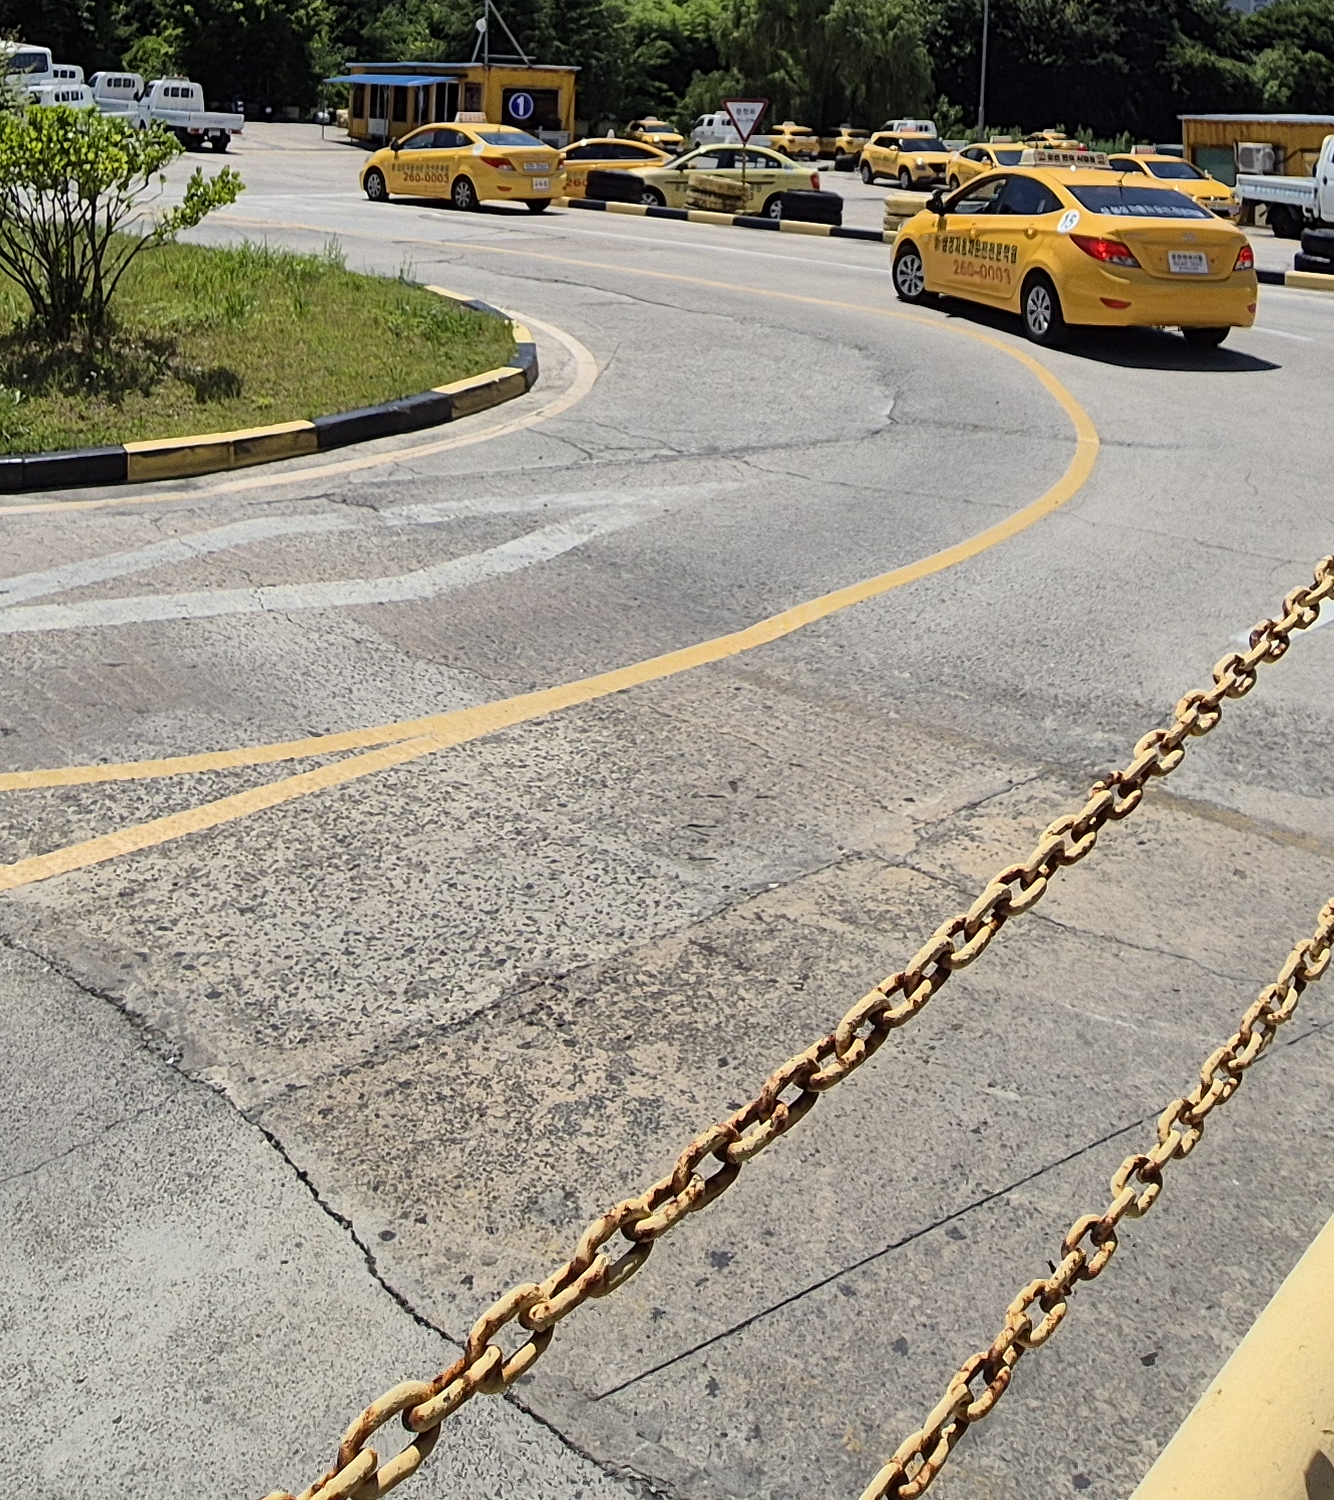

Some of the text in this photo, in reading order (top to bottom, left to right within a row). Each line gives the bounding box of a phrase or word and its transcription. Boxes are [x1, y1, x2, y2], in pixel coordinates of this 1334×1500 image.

[403, 171, 450, 184] 260-0003
[1061, 212, 1077, 231] 15
[953, 259, 1011, 285] 260-0003
